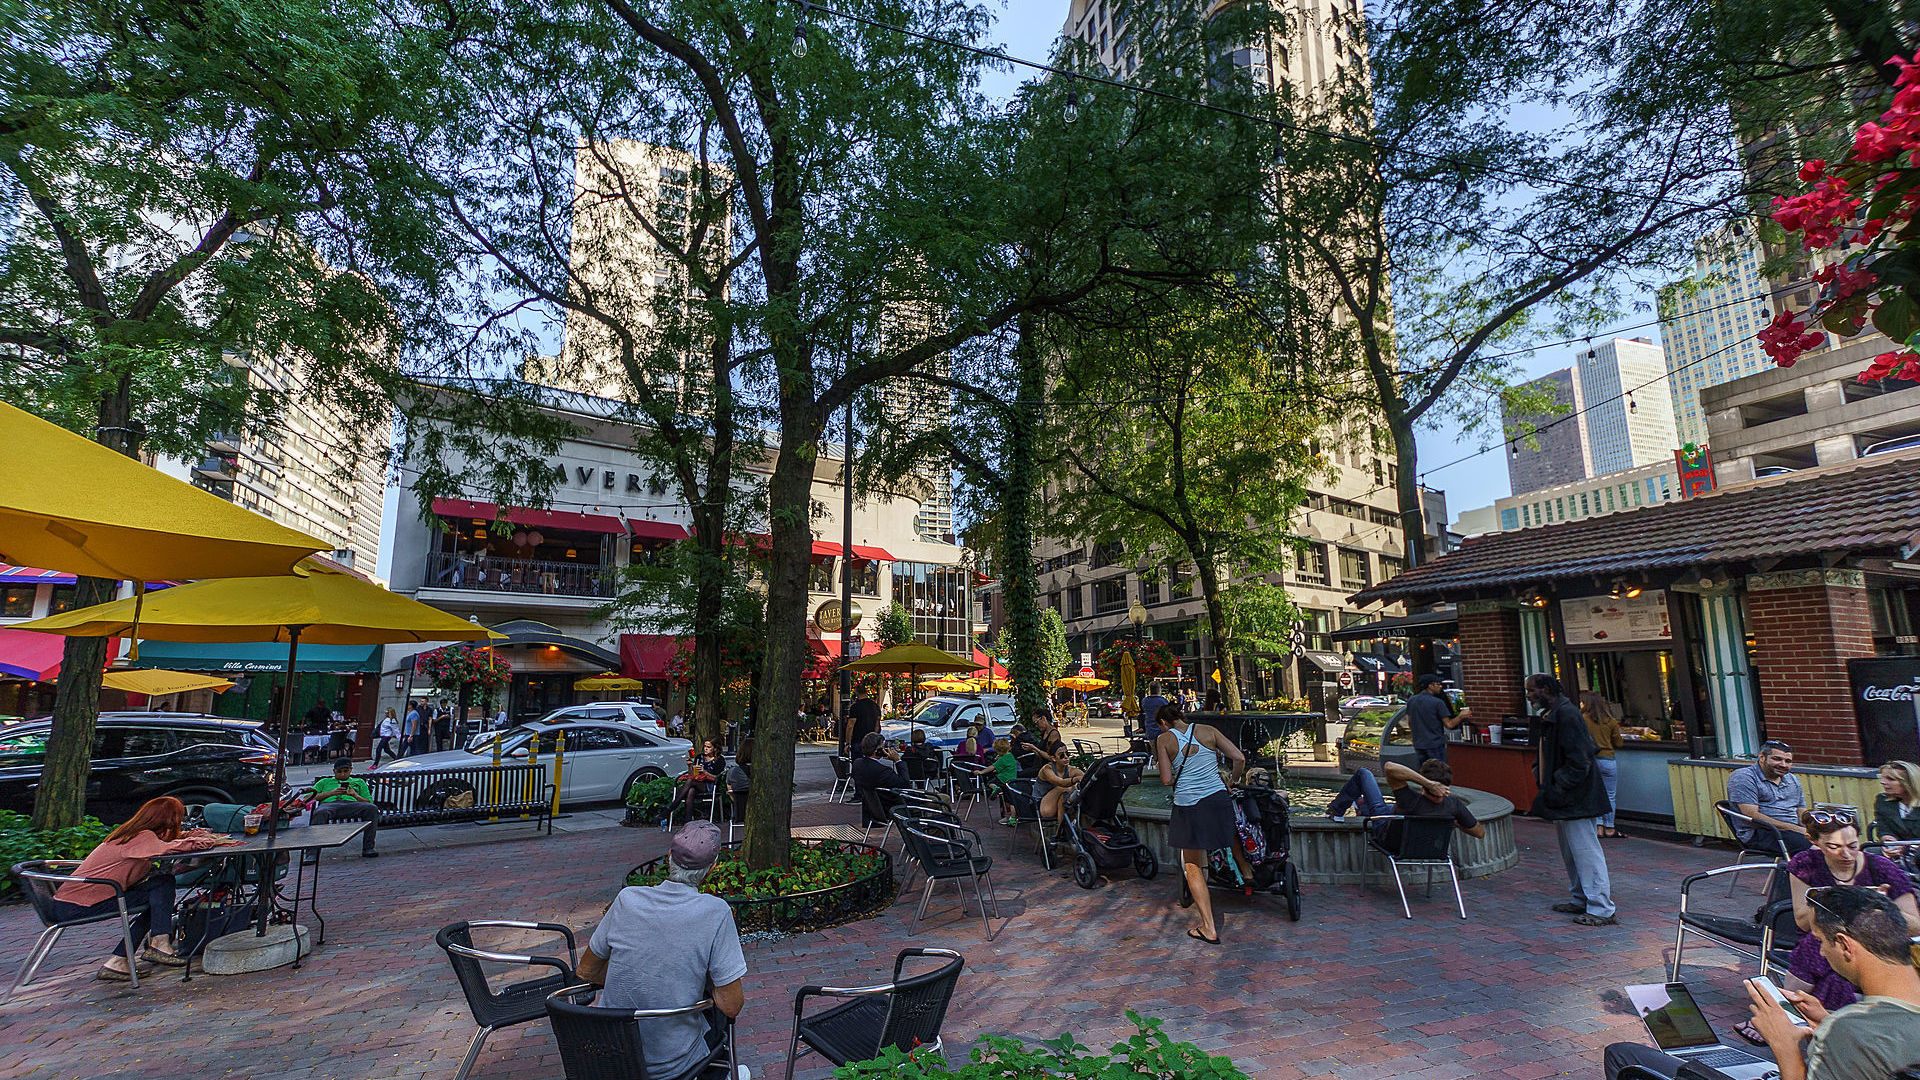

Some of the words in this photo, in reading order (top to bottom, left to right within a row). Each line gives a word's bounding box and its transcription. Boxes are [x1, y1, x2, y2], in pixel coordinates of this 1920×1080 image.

[552, 463, 668, 496] AVERN
[820, 608, 841, 619] TAVER
[1377, 628, 1406, 638] GELATO
